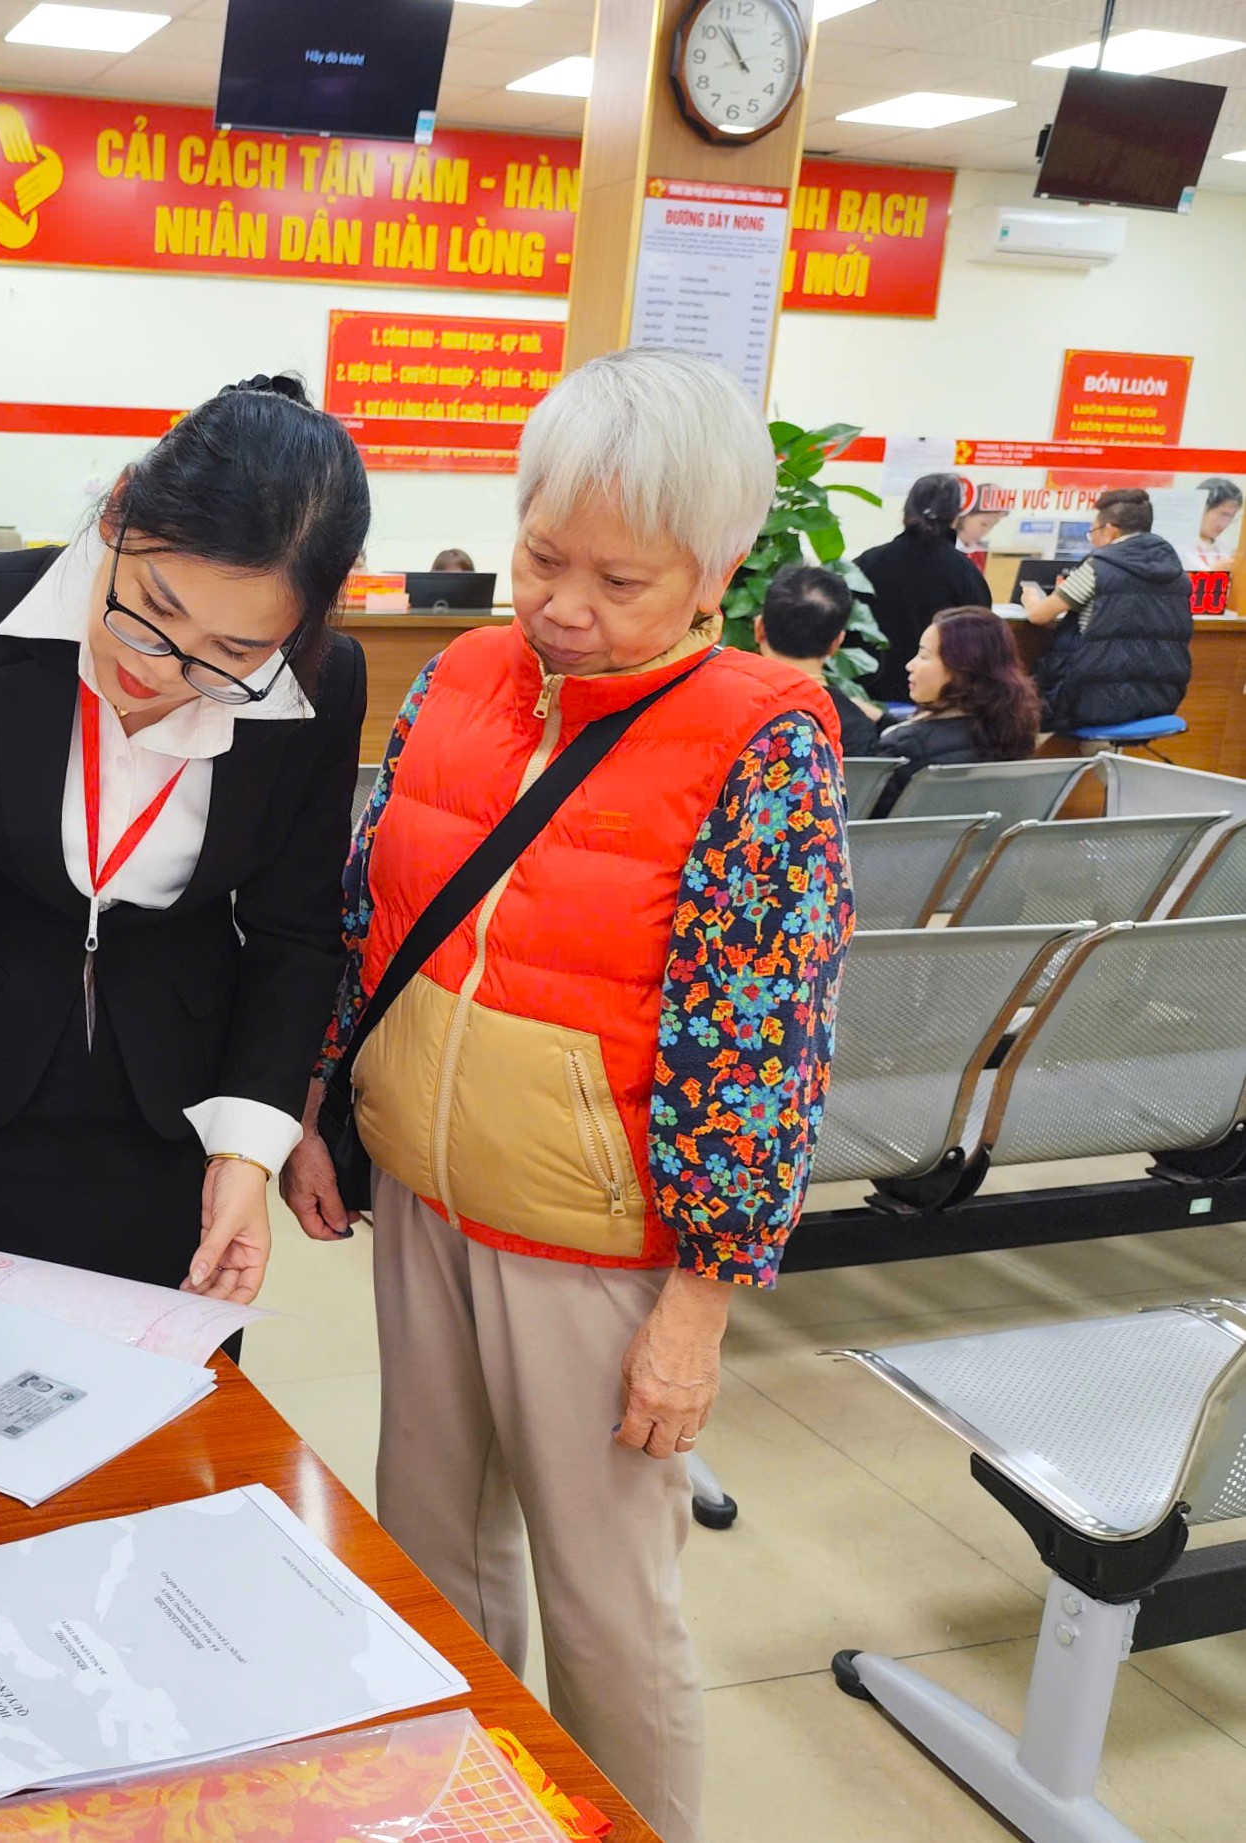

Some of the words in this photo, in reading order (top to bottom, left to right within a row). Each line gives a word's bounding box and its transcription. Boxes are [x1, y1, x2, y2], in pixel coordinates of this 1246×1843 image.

[719, 6, 731, 21] 11
[737, 2, 755, 17] 12
[702, 25, 717, 40] 10
[771, 32, 783, 47] 2
[693, 49, 706, 64] 9
[773, 58, 785, 73] 3
[696, 75, 709, 90] 8
[763, 83, 775, 96] 4
[711, 93, 721, 108] 7
[747, 99, 759, 113] 5
[726, 105, 740, 120] 6
[96, 115, 166, 181] CẢI
[178, 129, 287, 190] CÁCH
[299, 138, 376, 204] TẬN
[388, 146, 469, 204] TÂM
[837, 189, 928, 243] BẠCH
[708, 210, 729, 229] DÂY
[733, 213, 764, 231] NÓNG
[154, 200, 268, 260] NHÂN
[279, 208, 362, 266] DÂN
[372, 212, 438, 271] HÀI
[447, 216, 545, 278] LÒNG
[803, 243, 870, 297] MỚI
[1121, 375, 1168, 396] LUÔN
